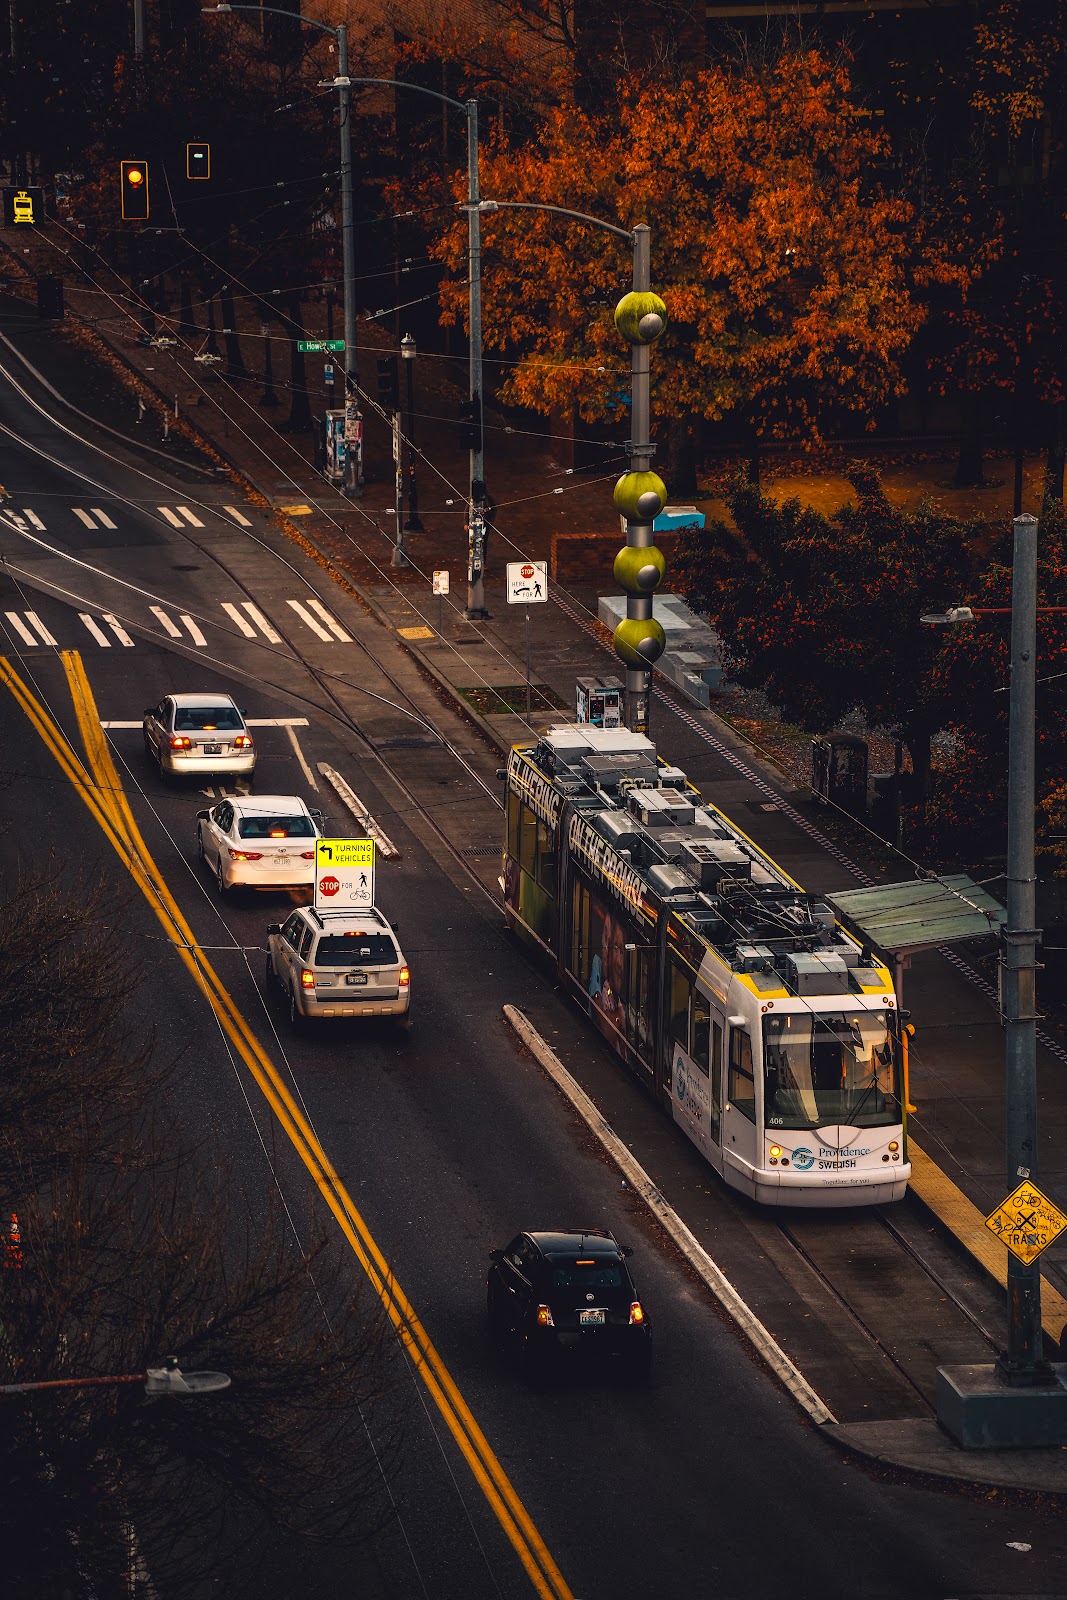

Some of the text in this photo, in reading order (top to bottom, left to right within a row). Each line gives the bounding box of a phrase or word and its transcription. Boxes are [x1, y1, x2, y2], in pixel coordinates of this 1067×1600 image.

[335, 844, 372, 852] TURNING
[319, 882, 339, 891] STOP
[769, 1117, 784, 1125] 406
[819, 1146, 870, 1158] Providence
[818, 1160, 857, 1170] SWEDISH
[1007, 1233, 1047, 1245] TRAKS
